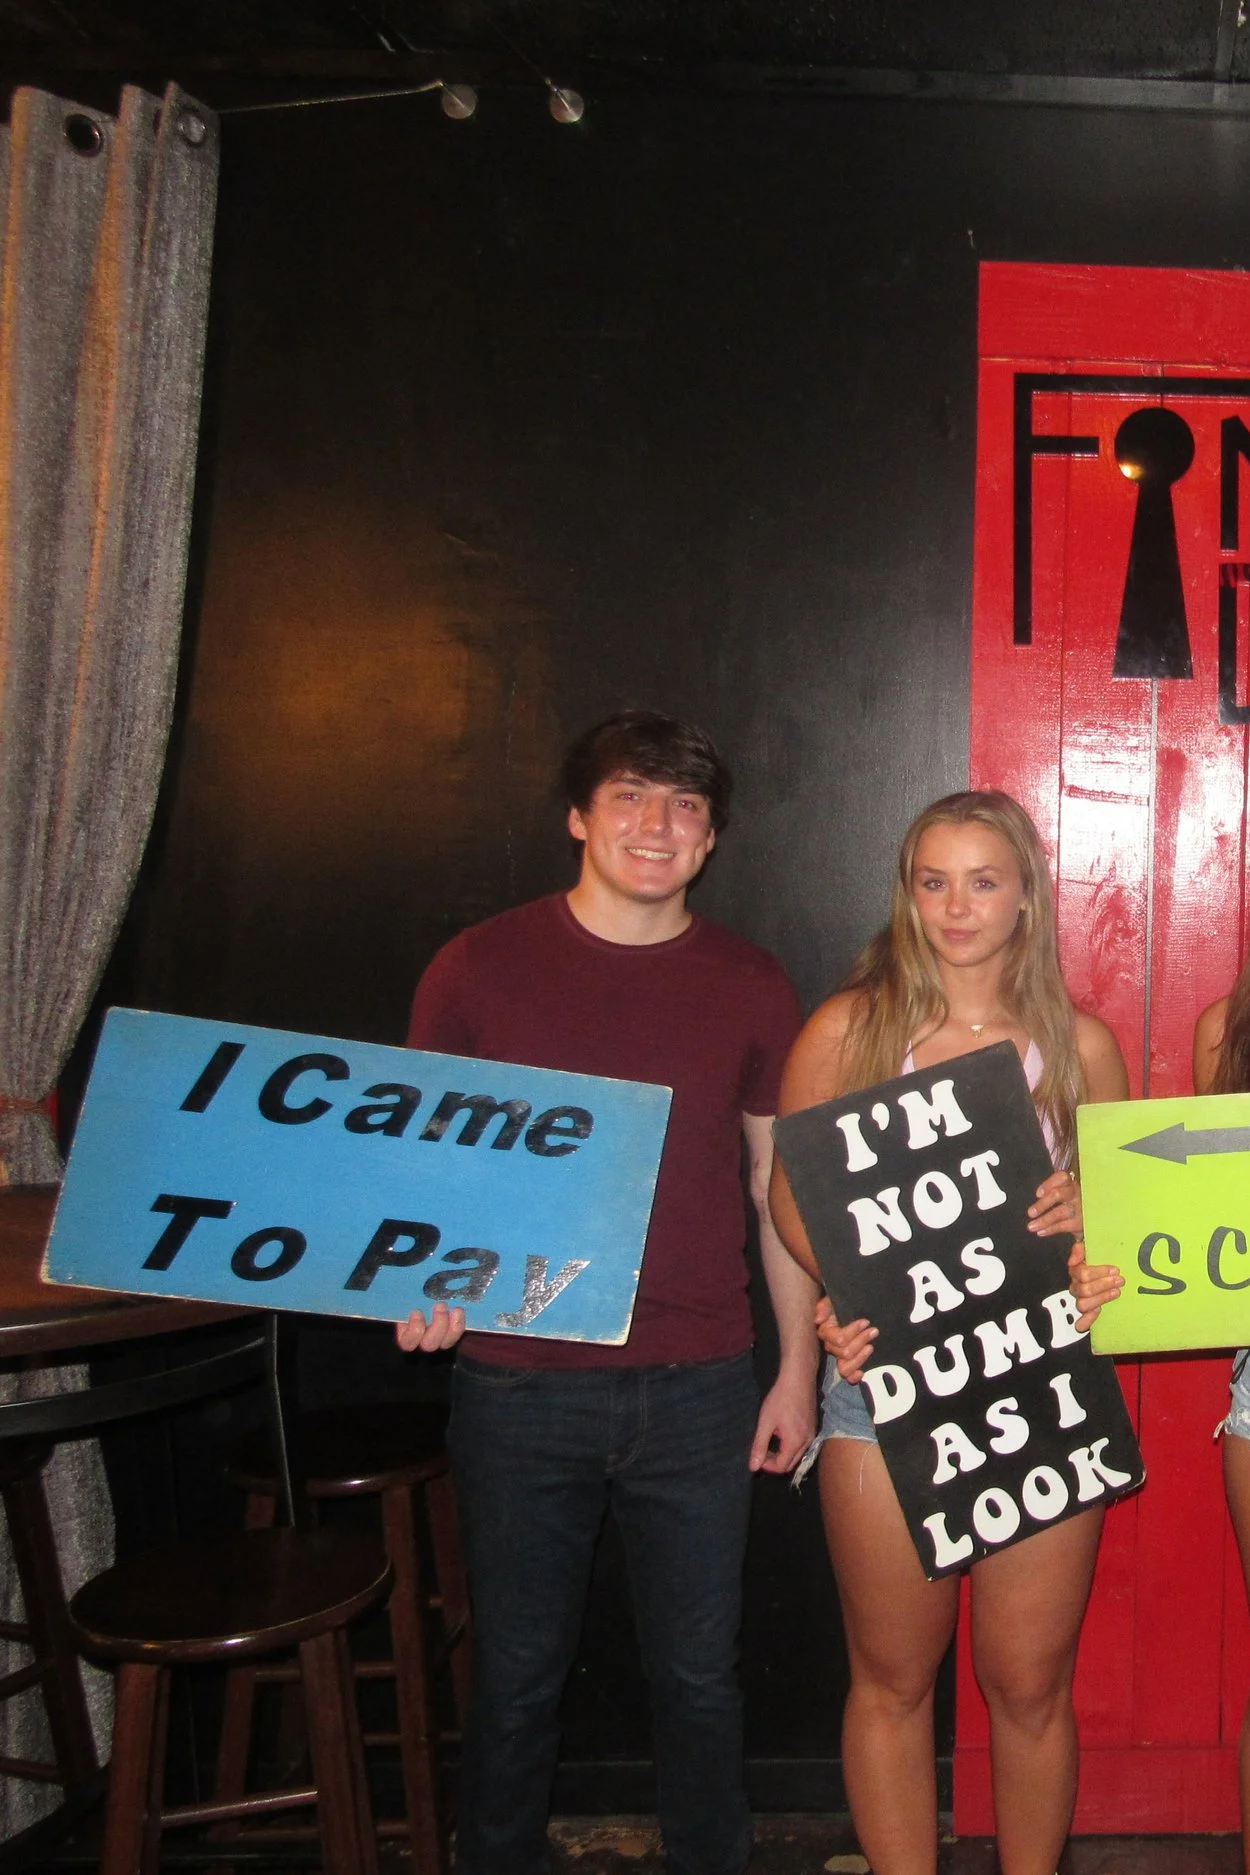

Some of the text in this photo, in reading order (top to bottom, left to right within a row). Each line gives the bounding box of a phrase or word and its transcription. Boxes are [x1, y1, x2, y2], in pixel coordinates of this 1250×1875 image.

[179, 1041, 594, 1157] I Came
[836, 1079, 973, 1172] I'M
[847, 1150, 1007, 1256] NOT
[141, 1193, 591, 1328] To Pay
[906, 1236, 1007, 1323] AS
[861, 1290, 1090, 1424] DUMB
[930, 1373, 1088, 1485] AS I
[922, 1438, 1132, 1568] LOOK
